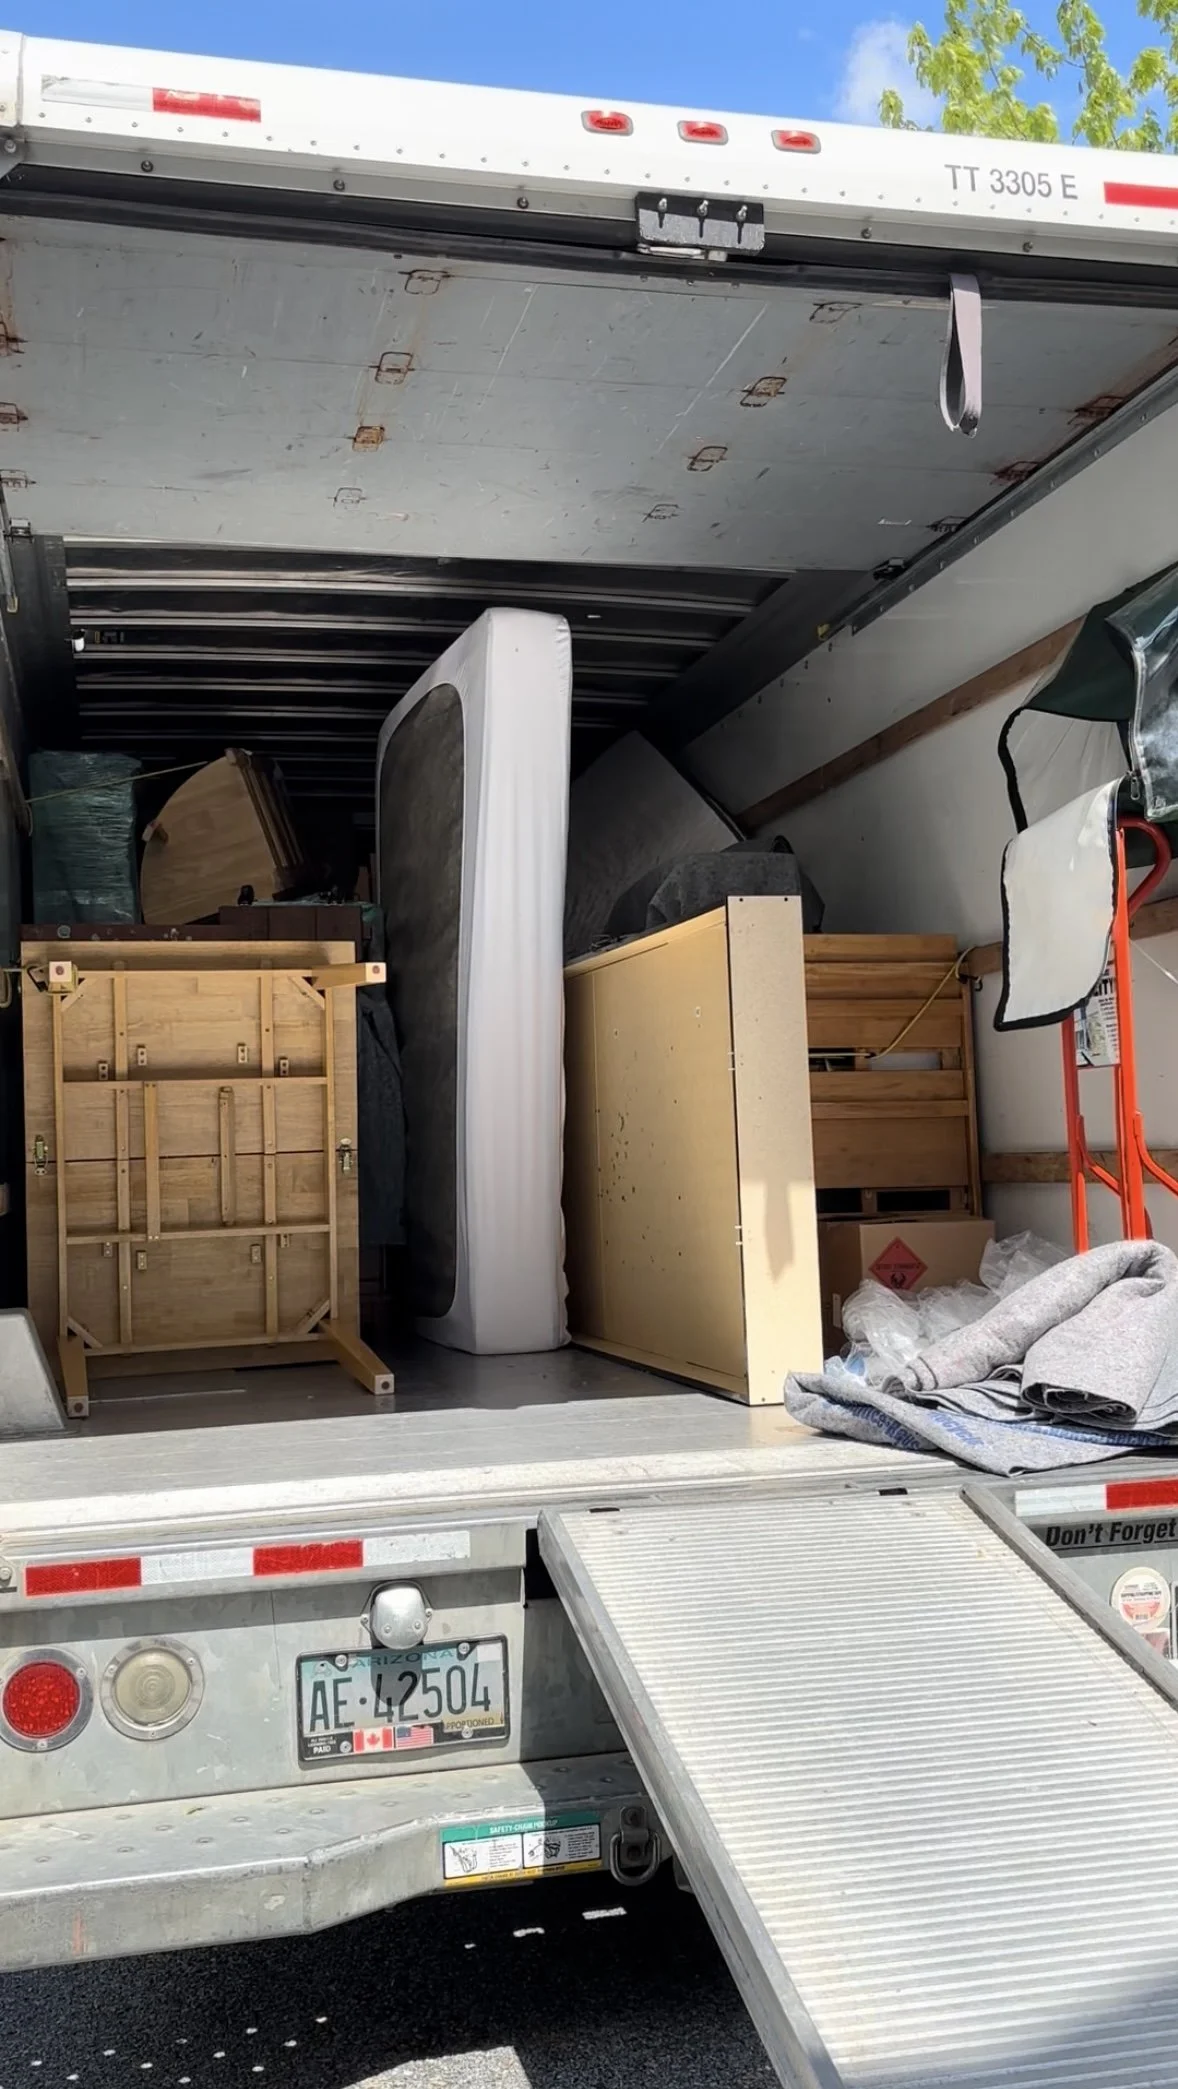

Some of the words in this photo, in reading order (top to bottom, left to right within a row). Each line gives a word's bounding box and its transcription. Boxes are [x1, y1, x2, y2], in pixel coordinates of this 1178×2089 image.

[944, 164, 980, 192] TT
[989, 168, 1052, 198] 3305
[1060, 173, 1079, 200] E
[1046, 1522, 1103, 1547] Don't
[1109, 1518, 1177, 1544] Forget
[352, 1649, 454, 1668] ARIZONA
[313, 1745, 331, 1754] PAID
